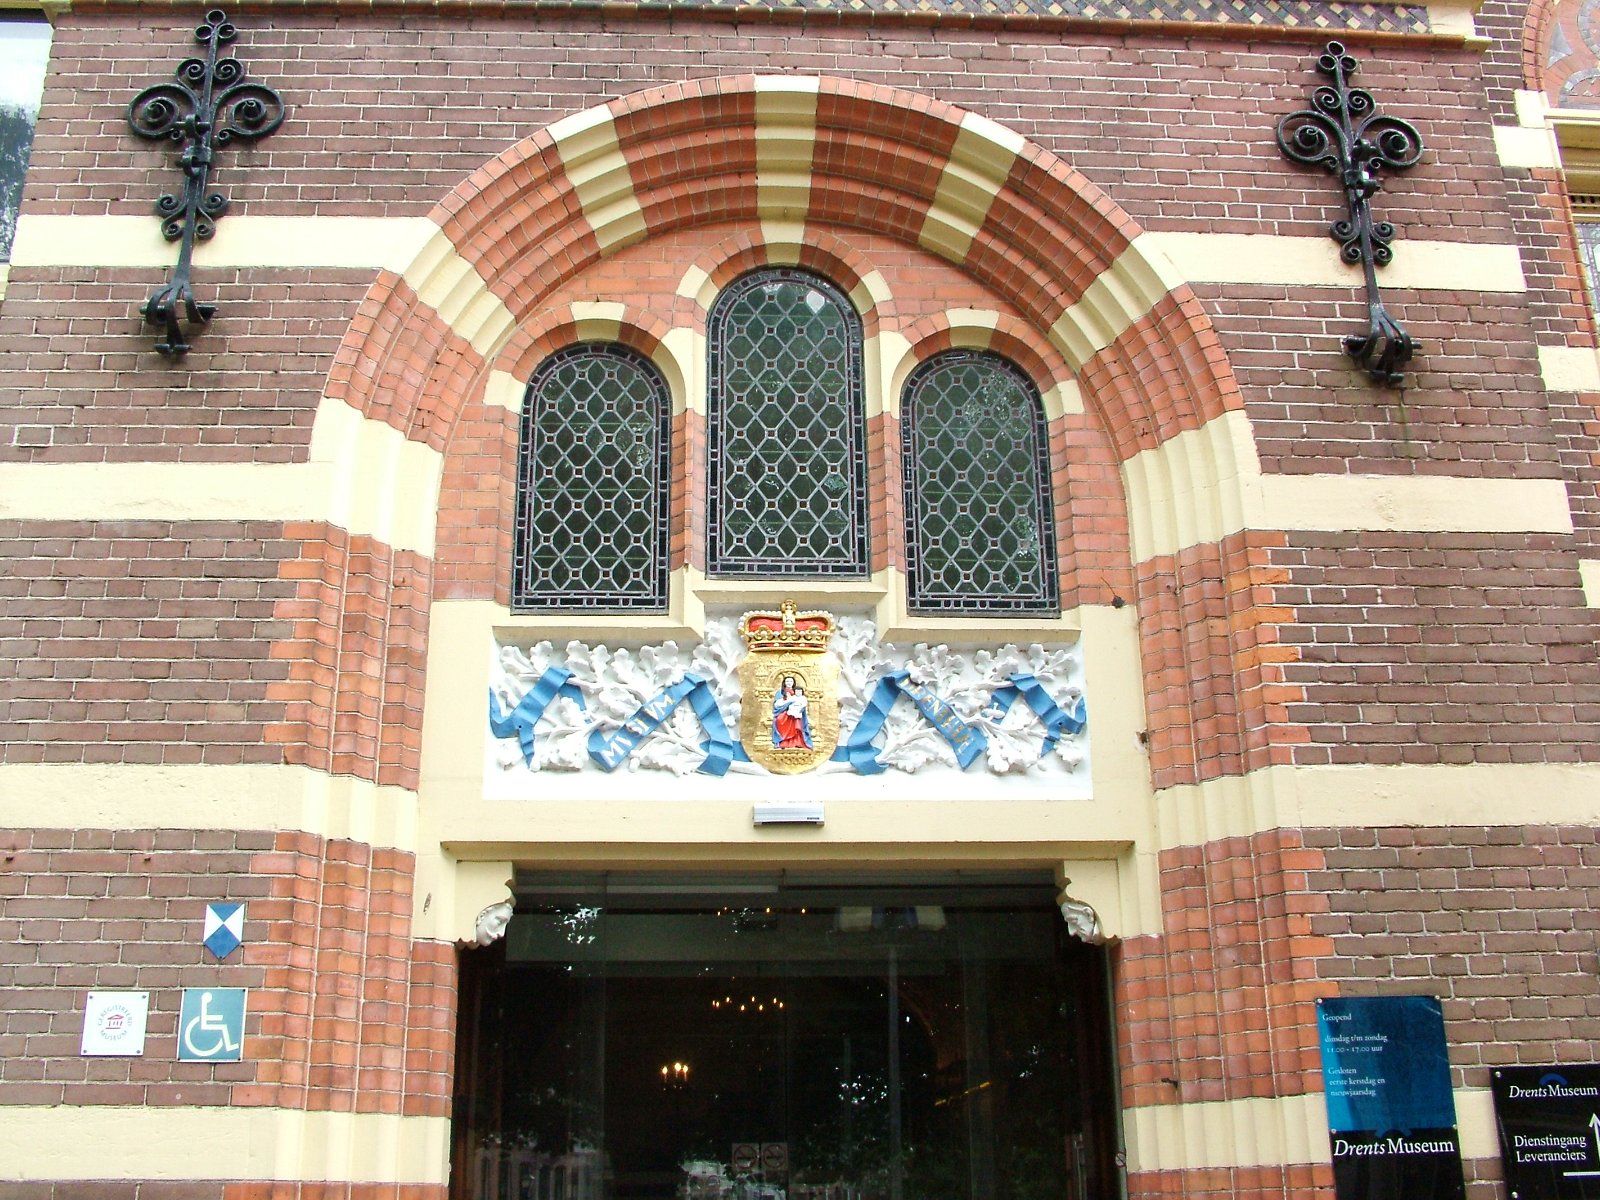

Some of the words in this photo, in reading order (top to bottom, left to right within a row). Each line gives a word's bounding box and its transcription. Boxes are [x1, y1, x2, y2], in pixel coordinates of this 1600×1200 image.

[1322, 1013, 1352, 1022] Geopend
[1324, 1034, 1350, 1043] dinsdag
[1364, 1033, 1388, 1042] zondag
[1328, 1066, 1357, 1075] Gesloten
[1514, 1135, 1587, 1148] Dienstingang
[1516, 1149, 1587, 1162] Leveranciers
